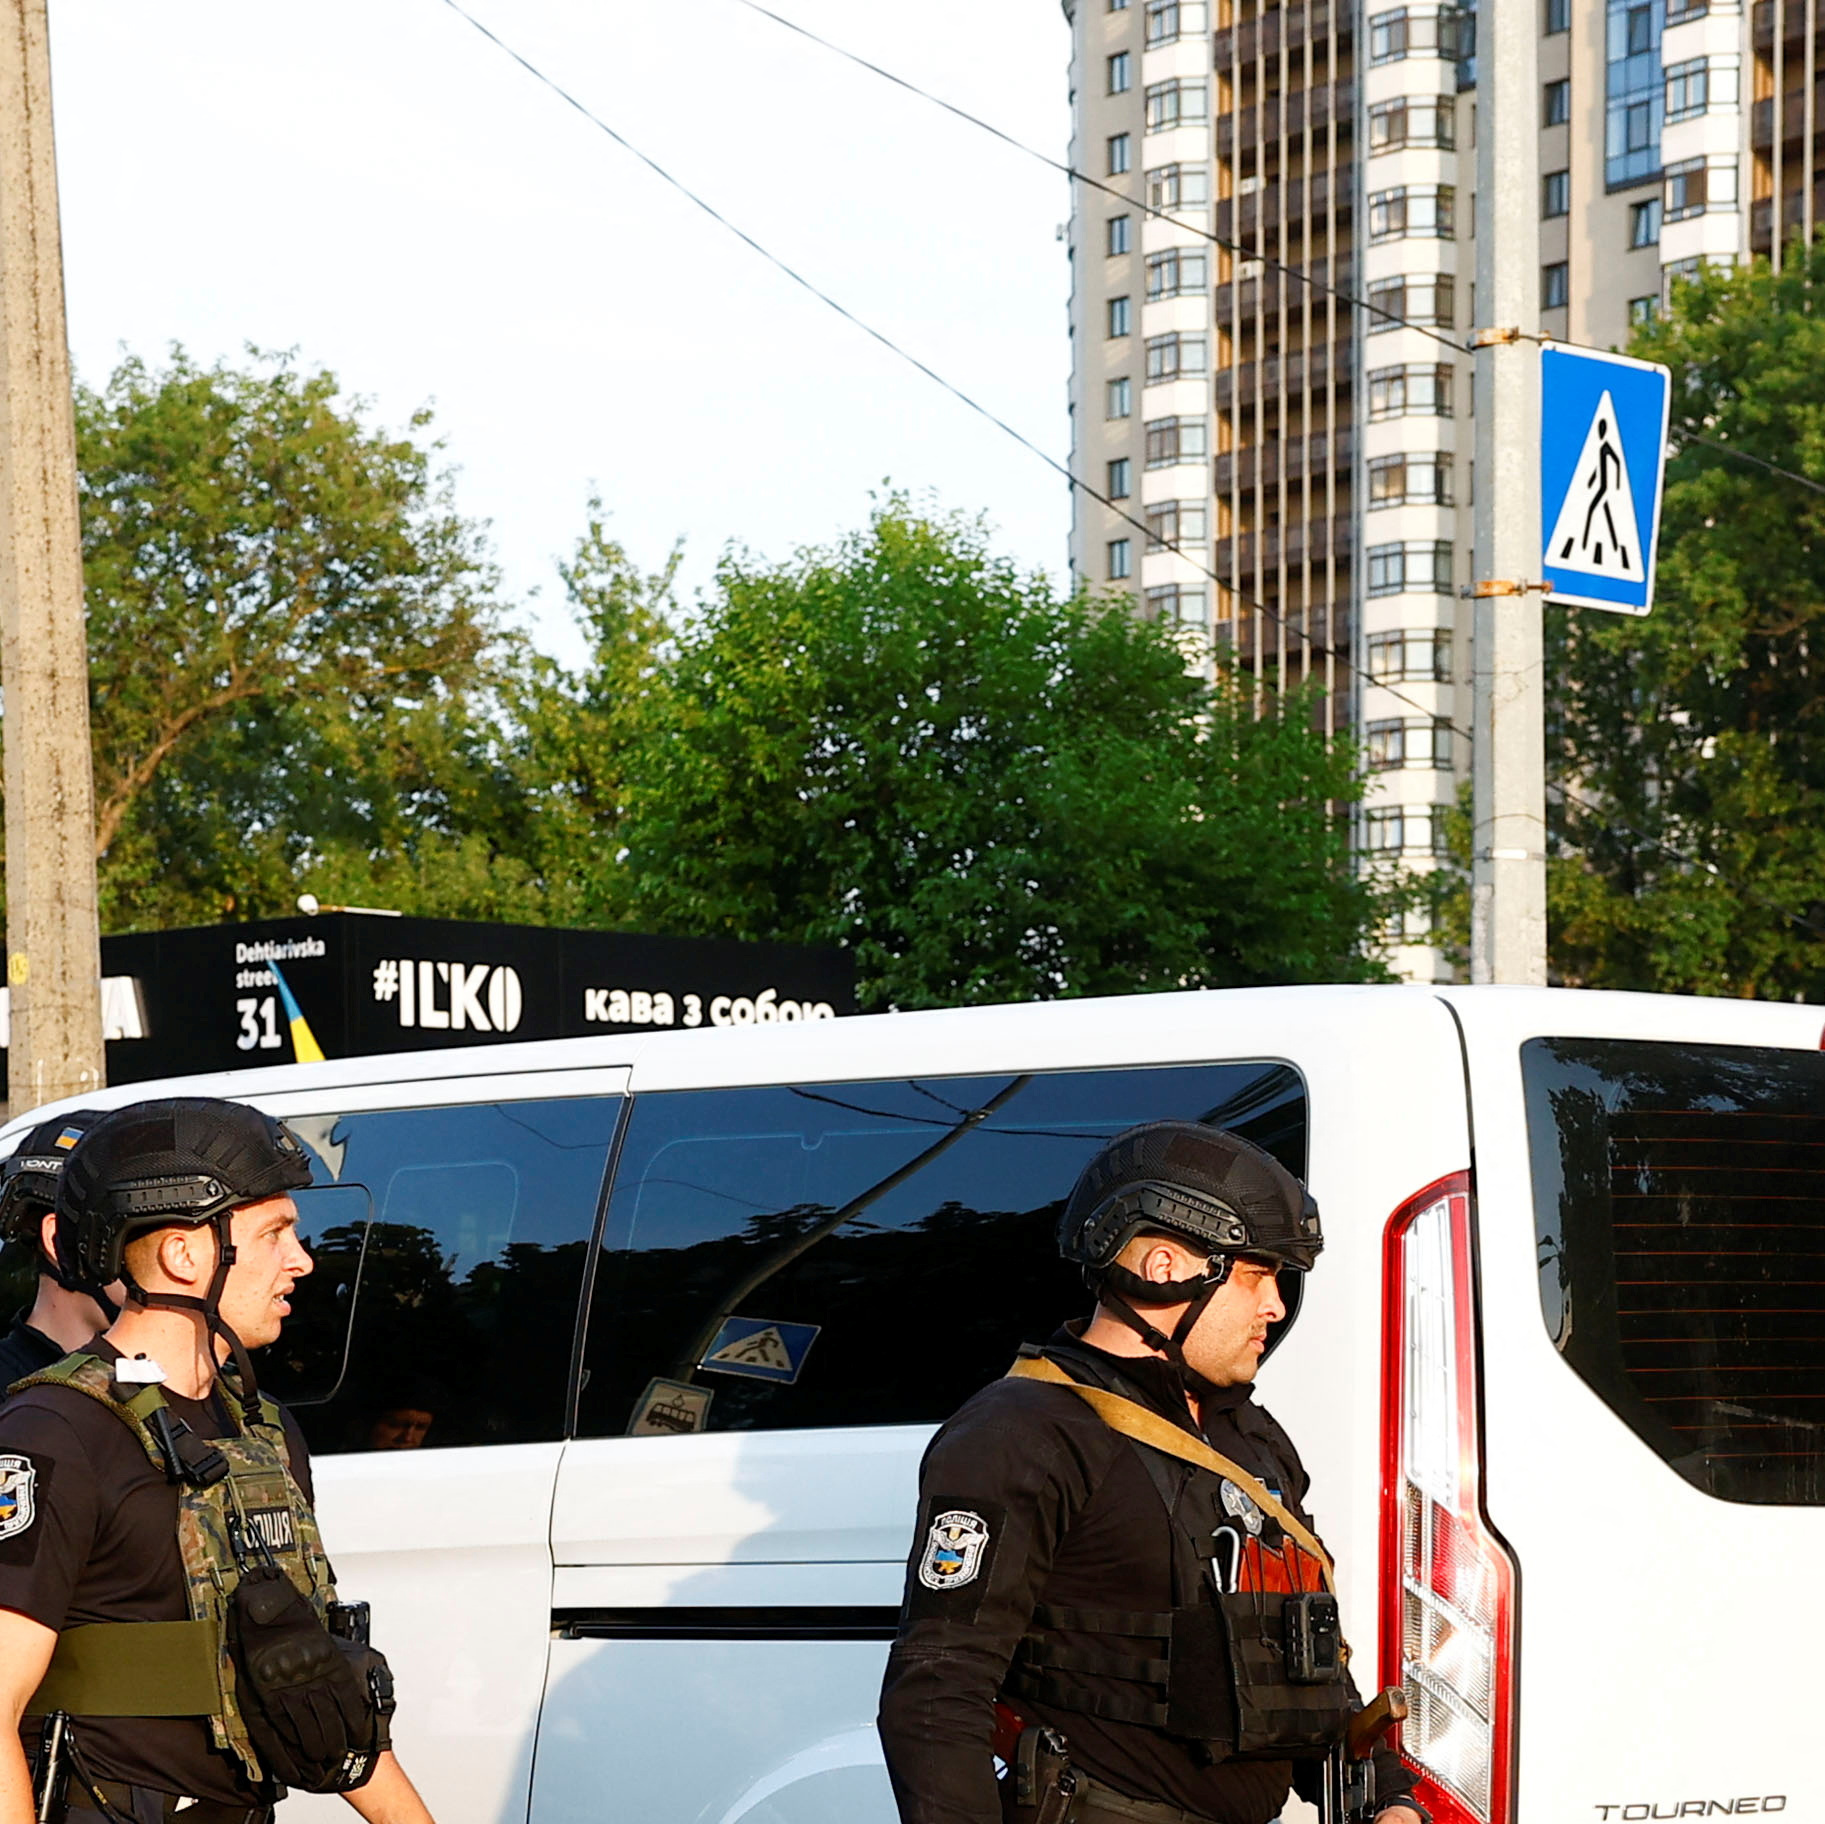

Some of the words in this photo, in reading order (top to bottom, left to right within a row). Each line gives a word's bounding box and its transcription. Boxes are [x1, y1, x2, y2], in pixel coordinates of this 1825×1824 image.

[236, 936, 326, 964] Dehtiarivska
[236, 996, 282, 1051] 31
[584, 988, 675, 1026] кава
[682, 993, 703, 1027] з
[709, 987, 836, 1027] собою
[229, 1511, 294, 1549] ОЛІЦІЯ
[1594, 1795, 1787, 1822] TOURNEO
